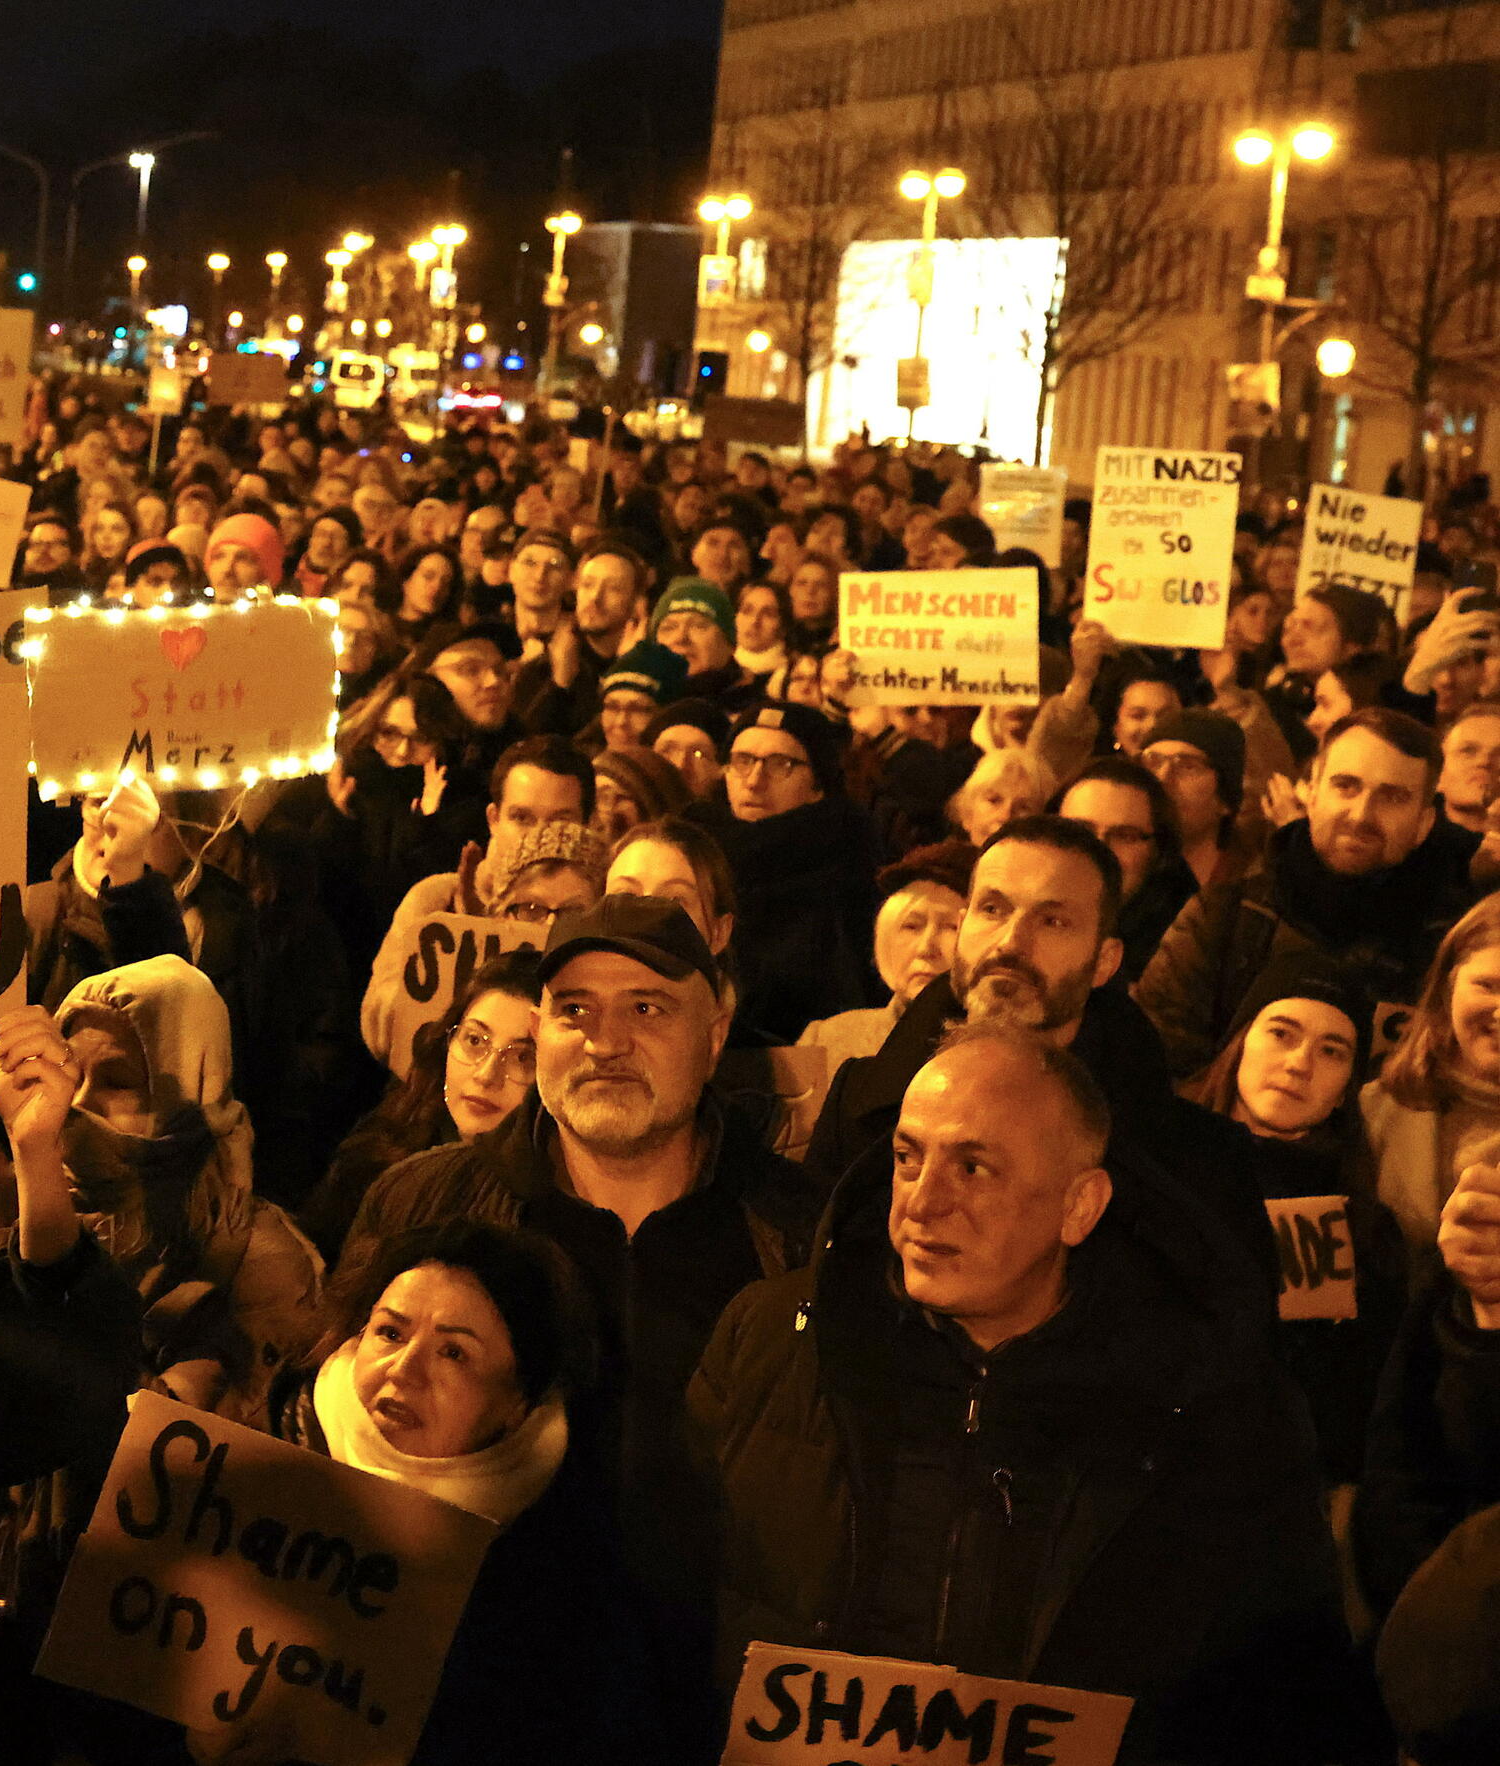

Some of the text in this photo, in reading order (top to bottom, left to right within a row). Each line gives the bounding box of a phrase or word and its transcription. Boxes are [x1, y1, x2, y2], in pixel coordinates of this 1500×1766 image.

[1104, 454, 1240, 484] MIT NAZIS
[1318, 493, 1366, 522] Nie
[1315, 527, 1412, 562] wieder
[1093, 563, 1220, 605] SWGLOS
[848, 626, 944, 650] RECHTE
[131, 678, 246, 718] Statt
[1274, 1211, 1353, 1290] NDE
[116, 1420, 400, 1618] Shame
[110, 1576, 387, 1726] on you.
[745, 1663, 1075, 1766] SHAME
